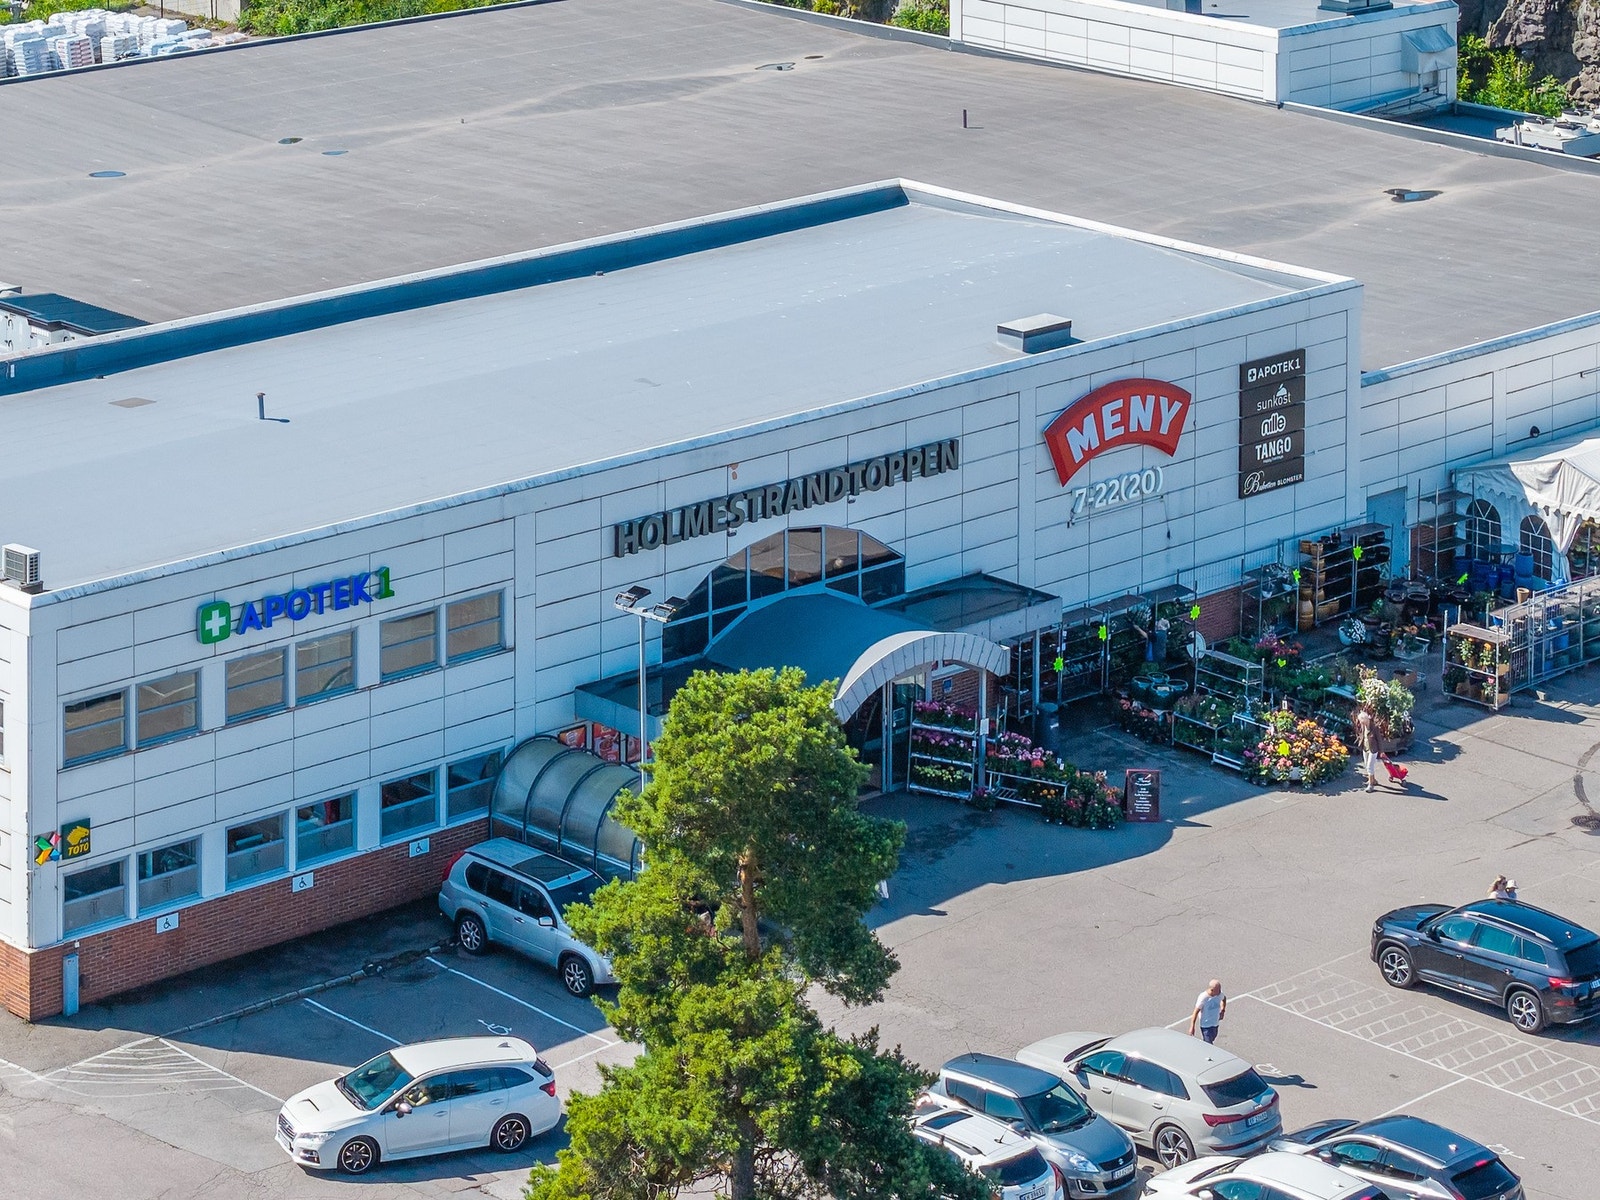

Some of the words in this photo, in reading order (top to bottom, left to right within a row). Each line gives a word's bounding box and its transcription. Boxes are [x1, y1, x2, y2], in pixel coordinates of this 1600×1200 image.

[1256, 391, 1291, 411] sunkost
[1065, 395, 1183, 464] MENY
[1255, 436, 1292, 461] TANGO
[1074, 466, 1163, 514] 7-22(20)
[1276, 473, 1303, 487] BLOMSTER
[614, 438, 960, 558] HOLMESTRANDTOPPEN
[68, 842, 89, 856] TOTO
